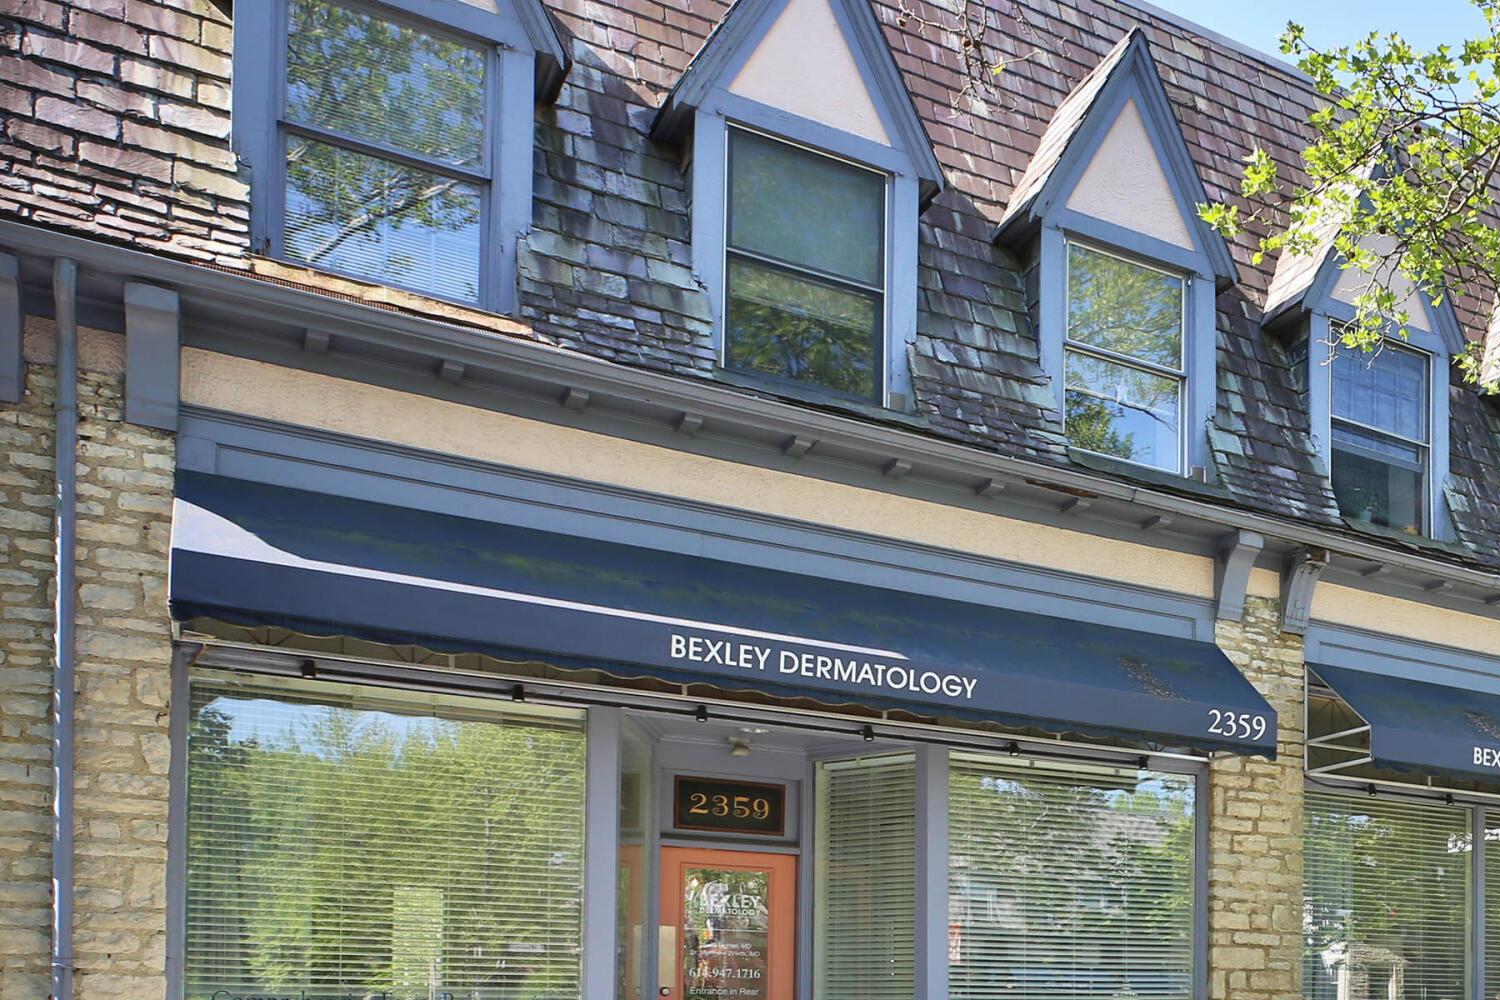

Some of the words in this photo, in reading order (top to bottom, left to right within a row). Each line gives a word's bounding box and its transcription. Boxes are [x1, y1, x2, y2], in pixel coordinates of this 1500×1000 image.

[671, 634, 770, 671] BEXLEY
[779, 651, 978, 699] DERMATOLOGY
[1207, 709, 1267, 741] 2359
[689, 793, 771, 821] 2359
[689, 986, 728, 996] Entrance
[729, 986, 738, 996] in
[739, 987, 759, 996] Rear
